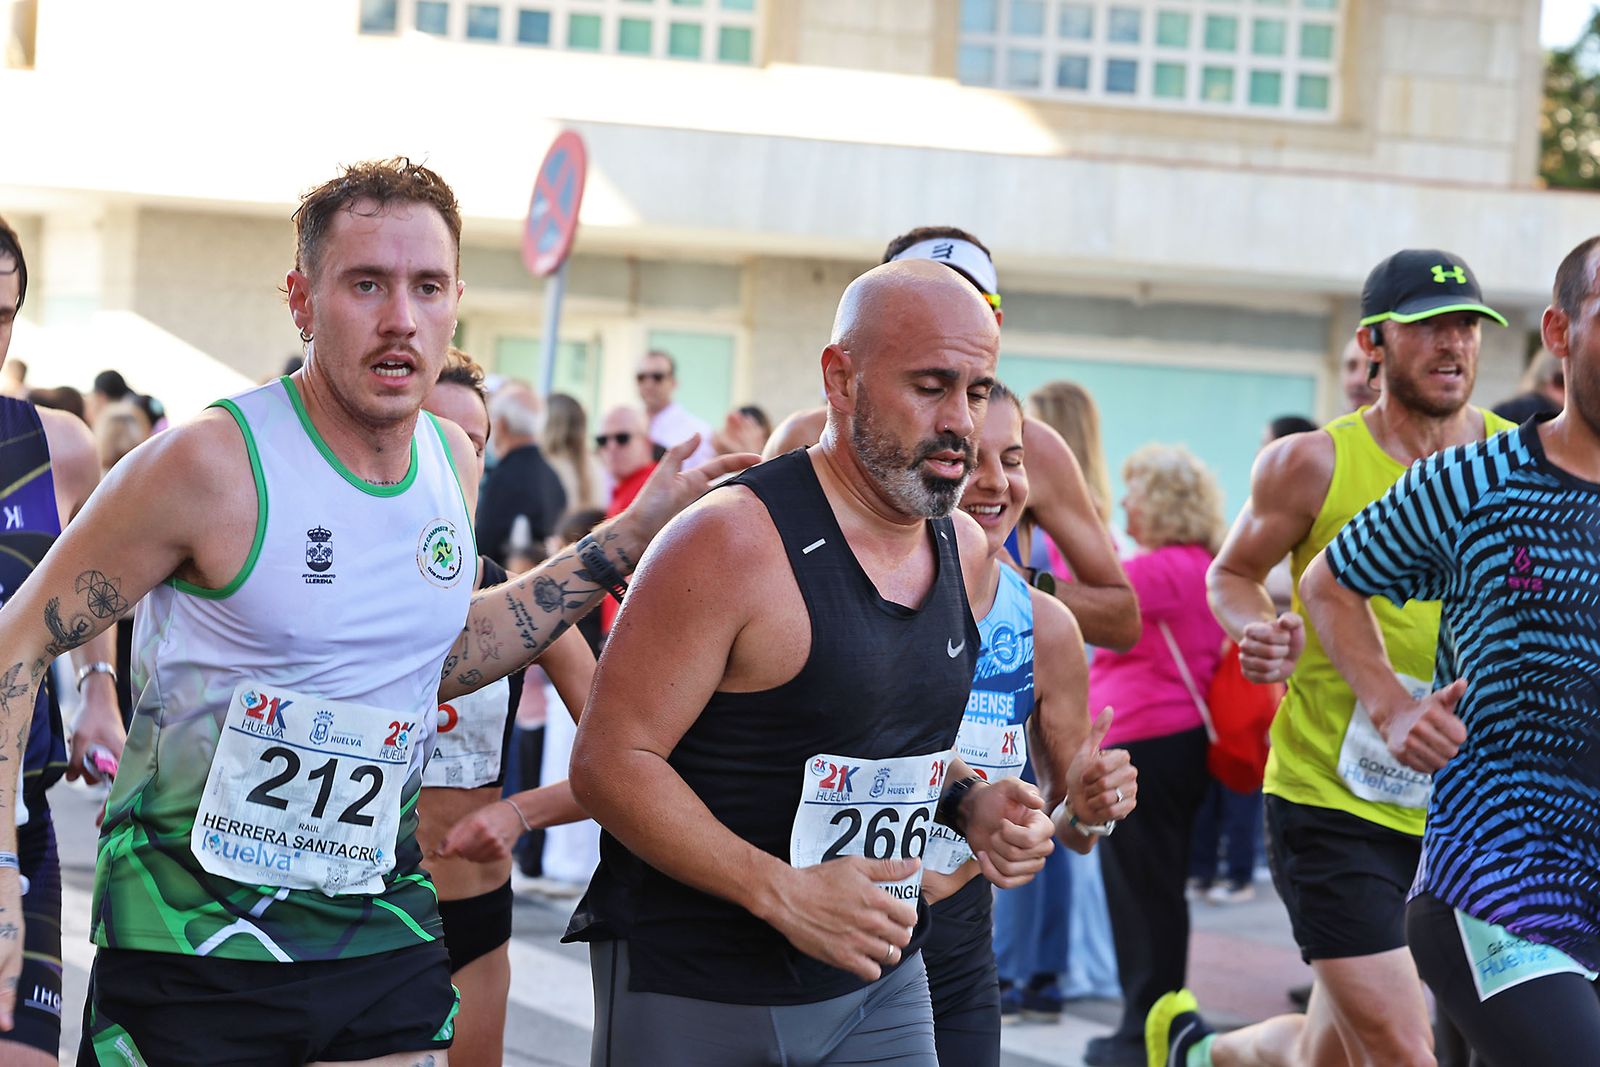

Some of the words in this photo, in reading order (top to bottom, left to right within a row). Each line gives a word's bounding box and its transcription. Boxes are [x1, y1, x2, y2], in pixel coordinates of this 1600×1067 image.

[246, 692, 294, 731] 21K
[241, 719, 284, 740] HUELVA
[330, 734, 362, 748] HUELVA
[960, 747, 989, 759] HUELVA
[1002, 729, 1019, 756] 21K
[246, 745, 386, 829] 212
[818, 762, 861, 793] 21K
[815, 791, 851, 802] HUELVA
[886, 786, 916, 796] HUELVA
[203, 812, 288, 847] HERRERA
[298, 822, 321, 834] RAUL
[821, 806, 931, 864] 266
